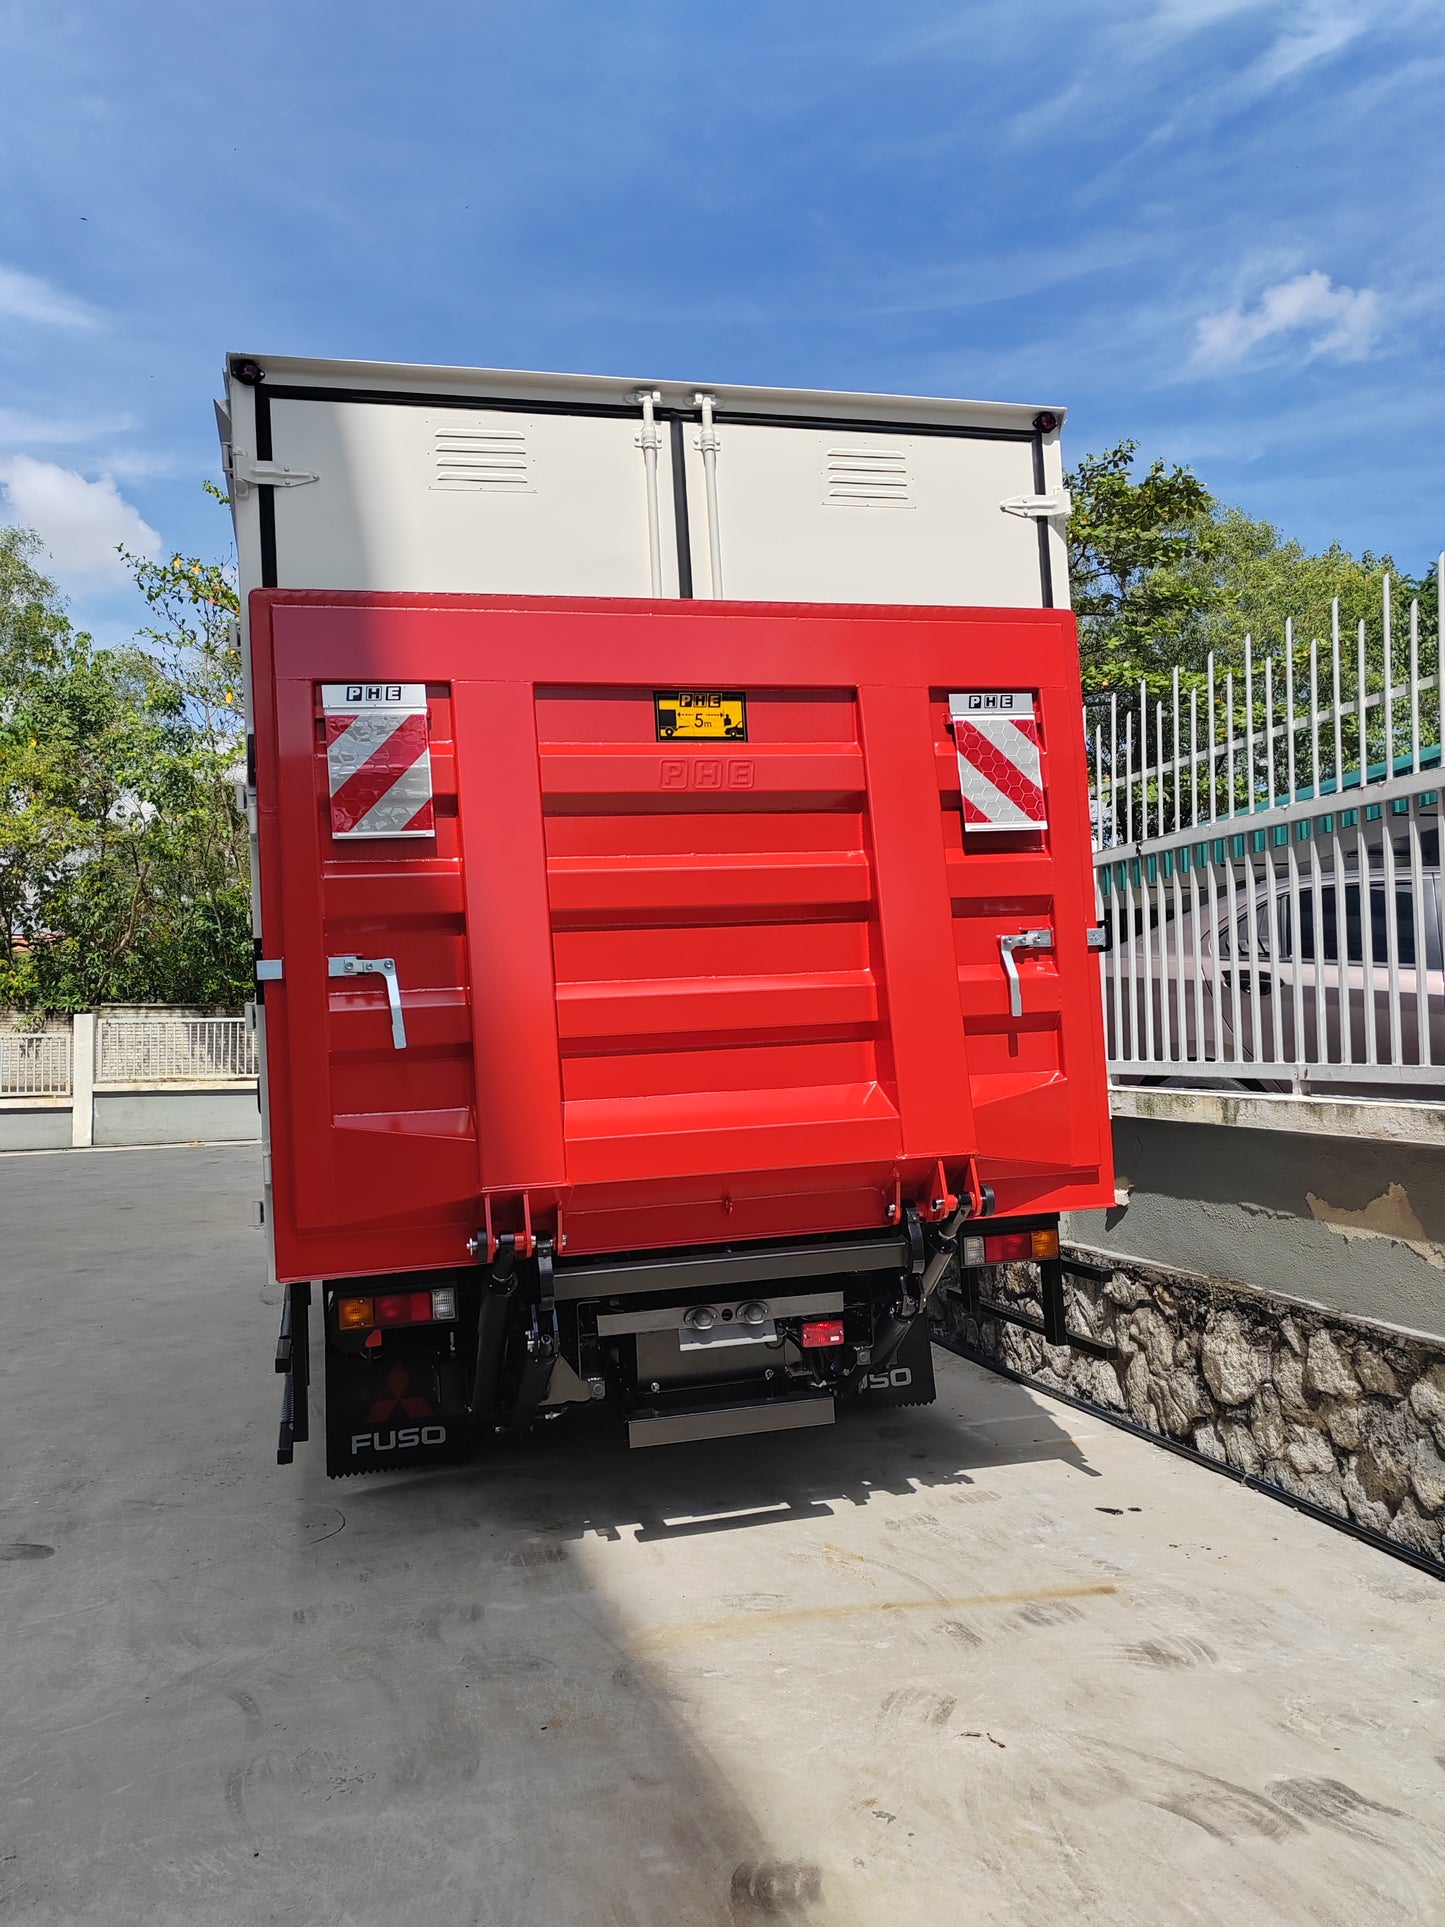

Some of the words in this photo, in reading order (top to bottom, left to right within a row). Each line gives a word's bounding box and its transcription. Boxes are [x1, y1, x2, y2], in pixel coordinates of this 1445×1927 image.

[346, 686, 401, 701] PHE
[679, 693, 721, 707] PHE
[969, 695, 1013, 708] PHE
[694, 713, 712, 728] 5m
[661, 760, 753, 788] PHE
[351, 1425, 446, 1455] FUSO
